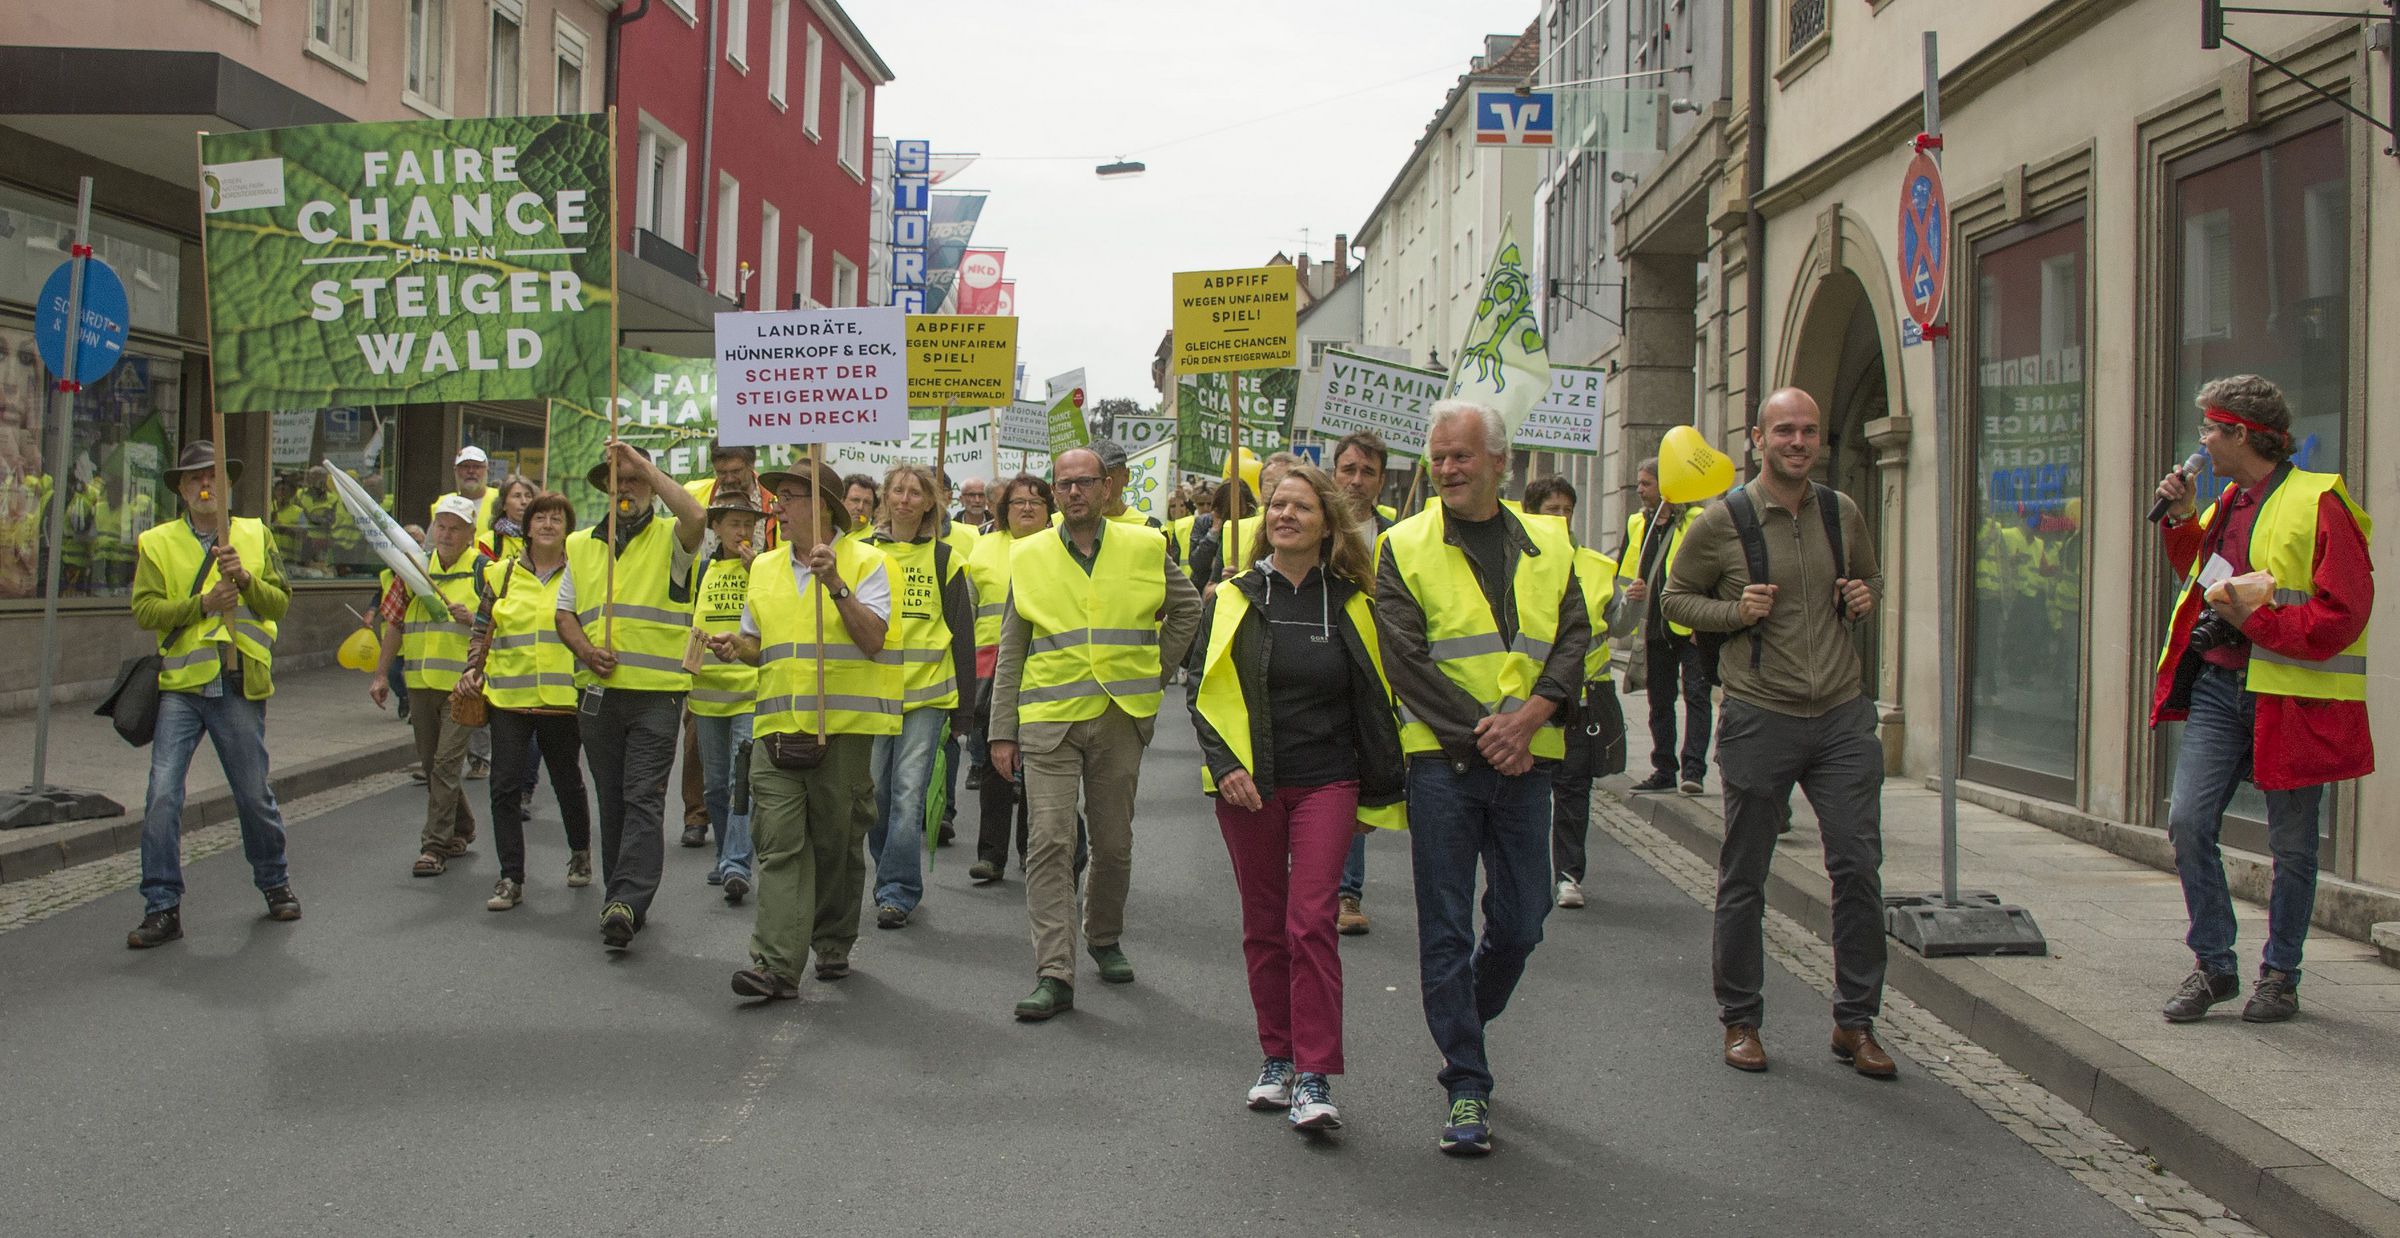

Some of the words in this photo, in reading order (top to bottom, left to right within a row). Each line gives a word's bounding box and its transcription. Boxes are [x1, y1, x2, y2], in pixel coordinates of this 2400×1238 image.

[364, 147, 519, 187] FAIRE
[297, 190, 588, 244] CHANCE
[895, 141, 927, 314] STORG
[396, 244, 440, 264] FÜR
[450, 246, 496, 260] DEN
[1204, 274, 1269, 288] ABPFIFF
[311, 270, 584, 321] STEIGER
[1183, 296, 1225, 307] WEGEN
[1229, 292, 1289, 305] UNFAIREM
[1212, 309, 1260, 323] SPIEL!
[757, 319, 863, 338] LANDRÄTE,
[916, 323, 986, 332] ABPFIFF
[357, 328, 543, 375] WALD
[942, 340, 1006, 349] UNFAIREM
[1185, 340, 1231, 352] GLEICHE
[1233, 336, 1287, 348] CHANCEN
[725, 345, 838, 361] HÜNNERKOPF
[844, 344, 853, 356] &
[859, 343, 897, 357] ECK,
[923, 353, 974, 363] SPIEL!
[1181, 355, 1200, 366] FÜR
[1202, 355, 1221, 365] DEN
[1223, 351, 1291, 362] STEIGERWALD!
[745, 366, 828, 383] SCHERT
[837, 364, 877, 379] DER
[654, 373, 717, 395] FAI
[908, 378, 941, 386] EICHE
[944, 378, 1001, 387] CHANCEN
[1213, 373, 1261, 393] FARE
[1333, 362, 1443, 401] VITAMIN
[1561, 374, 1598, 391] UR
[736, 386, 888, 405] STEIGERWALD
[932, 391, 1005, 399] STEIGERWALD!
[1198, 388, 1287, 417] CHANCE
[749, 412, 791, 427] NEN
[800, 409, 877, 425] DRECK!
[1006, 405, 1046, 418] REGIONAL
[1005, 415, 1046, 426] AUFSCHWU
[1529, 413, 1592, 427] ERWALD
[671, 426, 701, 440] FÜR
[910, 423, 991, 448] ZEHNT
[1004, 426, 1048, 437] STEIGERWA
[1200, 420, 1281, 448] STEIGER
[1516, 428, 1591, 443] ONALPARK
[840, 447, 865, 462] FÜR
[707, 581, 746, 589] CHANC
[908, 575, 933, 584] NCE
[708, 593, 747, 602] STEIGE
[715, 602, 744, 610] WALD
